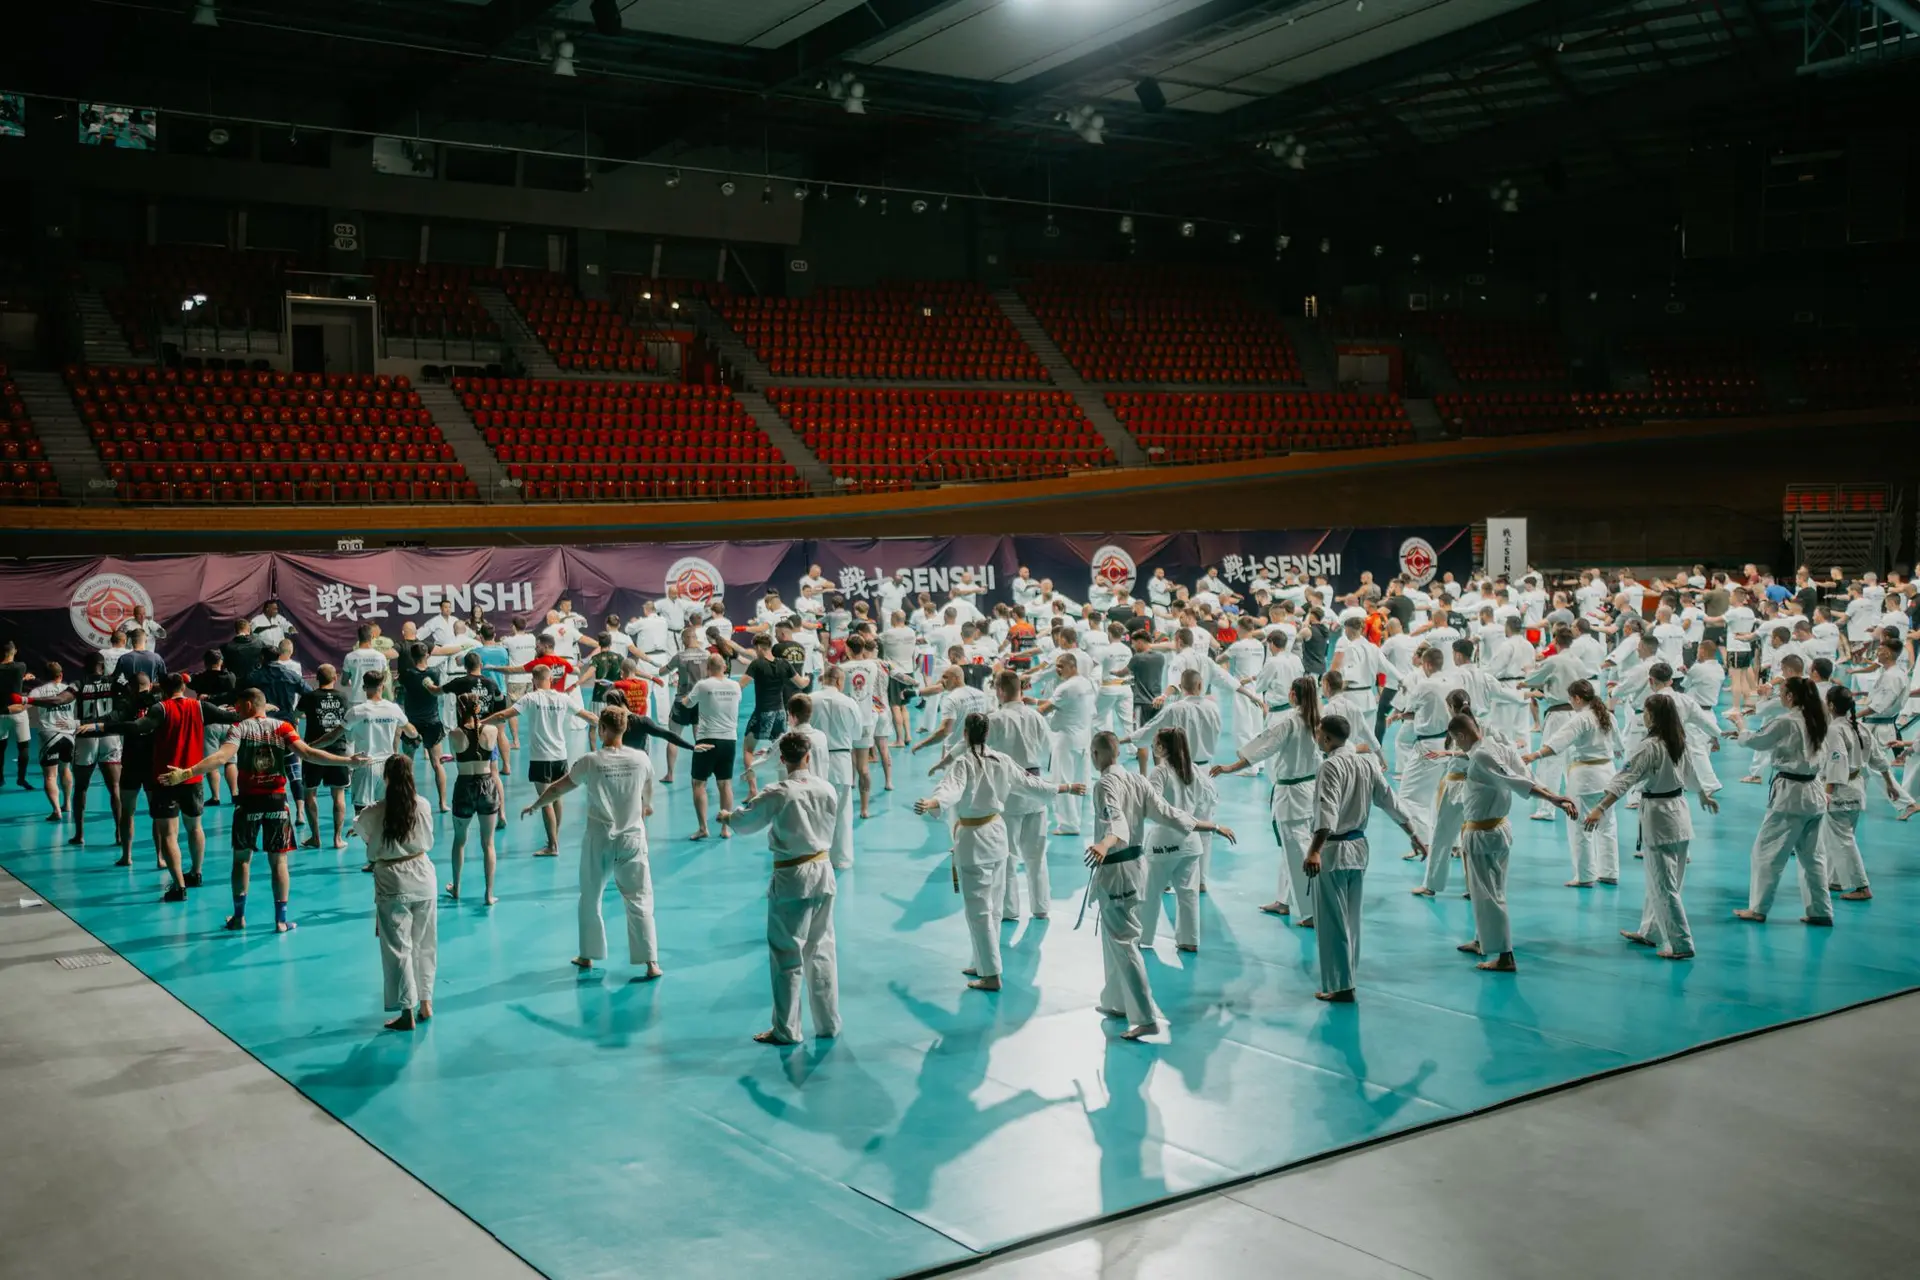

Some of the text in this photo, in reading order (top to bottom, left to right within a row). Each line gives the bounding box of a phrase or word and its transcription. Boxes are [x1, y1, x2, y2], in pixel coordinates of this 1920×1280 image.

[339, 239, 353, 249] VIP
[896, 564, 995, 595] SENSHI
[1264, 552, 1342, 580] SENSHI
[317, 583, 395, 622] 戦士
[397, 582, 534, 616] SENSHI
